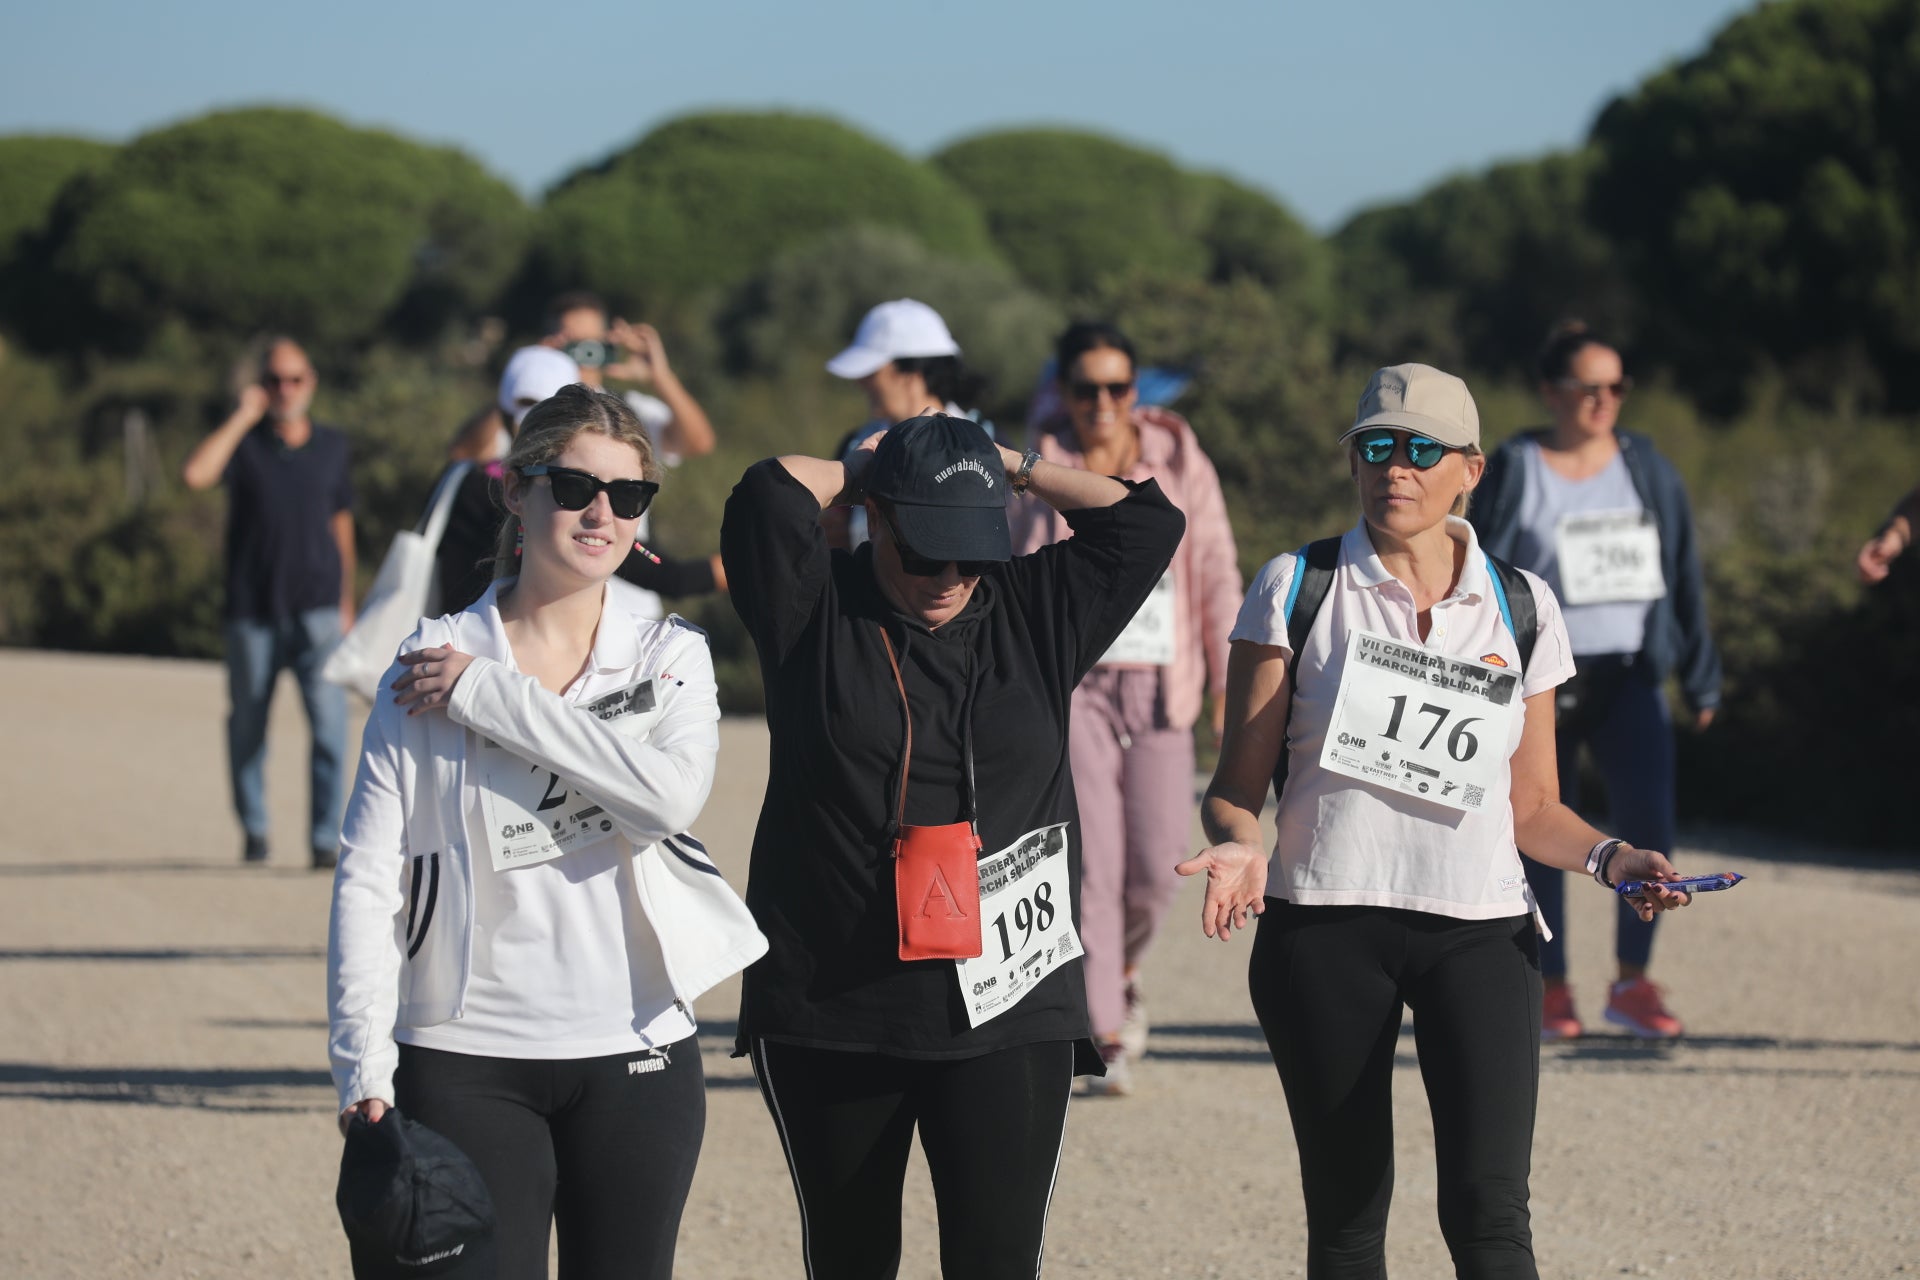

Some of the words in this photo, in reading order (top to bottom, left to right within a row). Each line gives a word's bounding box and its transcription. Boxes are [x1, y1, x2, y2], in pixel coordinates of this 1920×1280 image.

[1359, 651, 1368, 660] Y
[1371, 654, 1427, 680] MARCHA
[1362, 637, 1381, 651] VII
[1383, 645, 1446, 671] CARRERA
[1350, 736, 1366, 749] NB
[1377, 695, 1485, 762] 176
[516, 822, 534, 834] NB
[912, 863, 969, 920] A
[979, 876, 1009, 896] RCHA
[991, 881, 1055, 964] 198
[628, 1057, 665, 1075] PUMA
